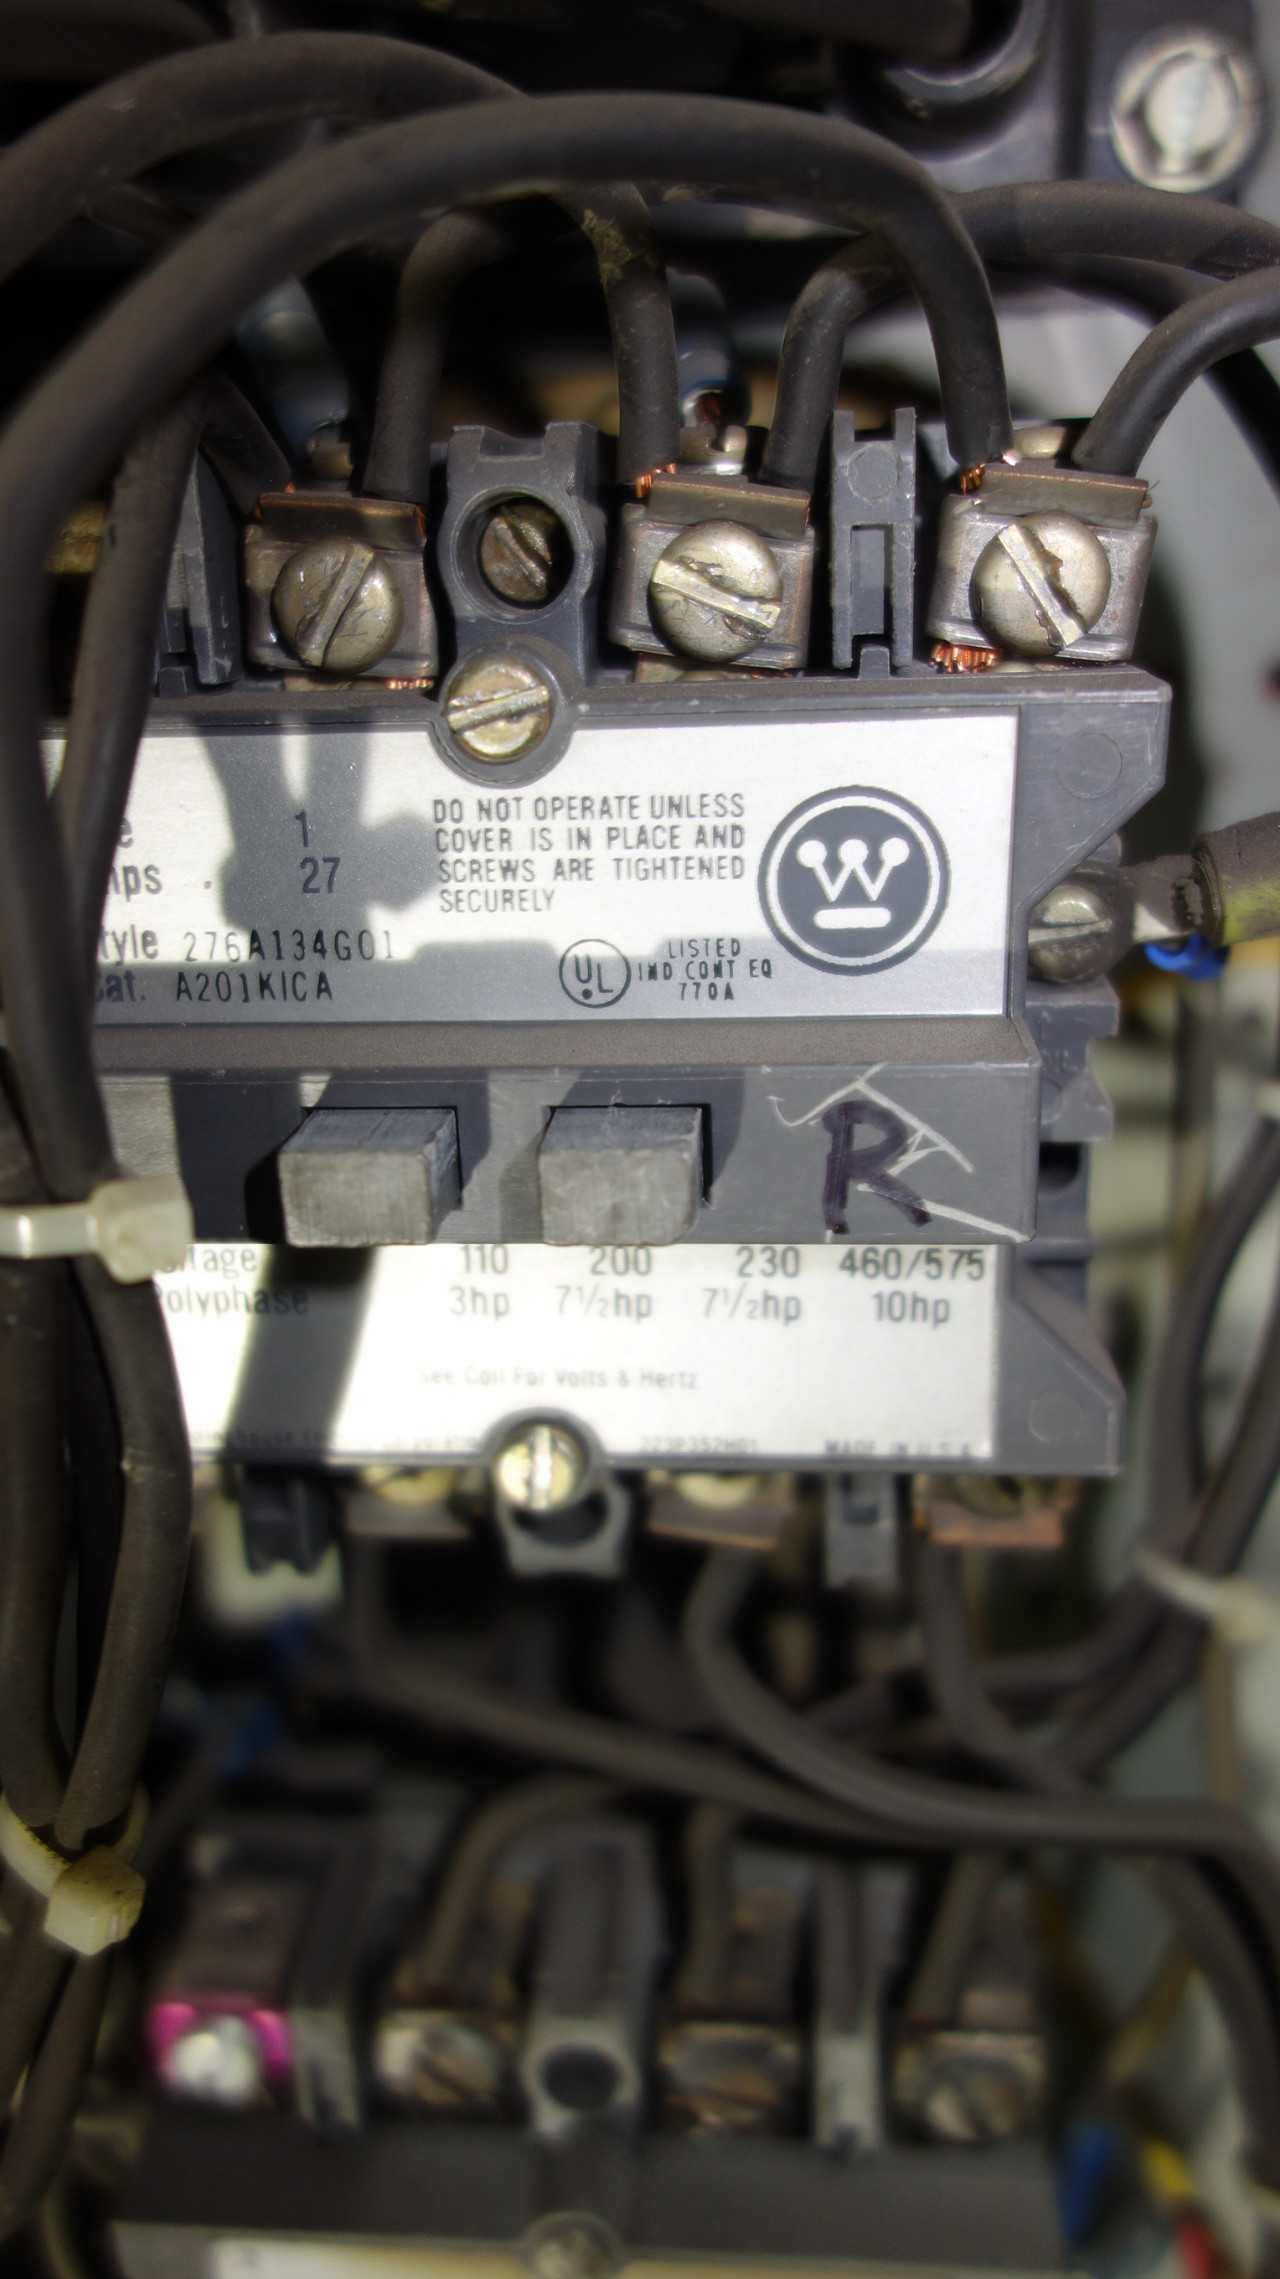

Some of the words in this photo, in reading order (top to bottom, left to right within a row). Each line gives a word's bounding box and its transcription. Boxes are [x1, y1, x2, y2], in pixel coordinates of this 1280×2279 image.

[433, 798, 463, 823] DO
[477, 797, 523, 822] NOT
[534, 795, 640, 820] OPERATE
[650, 793, 744, 819] UNLESS
[295, 809, 309, 848] 1
[435, 828, 512, 852] COVER
[531, 827, 553, 851] IS
[569, 827, 591, 850] IN
[606, 825, 681, 850] PLACE
[695, 824, 745, 849] AND
[301, 857, 340, 894] 27
[439, 858, 535, 883] SCREWS
[553, 857, 594, 881] ARE
[613, 855, 745, 881] TIGHTENED
[440, 888, 555, 913] SECURELY
[668, 937, 741, 959] LISTED
[638, 961, 673, 981] IND
[686, 959, 735, 980] CONT
[750, 959, 772, 979] EQ
[679, 982, 734, 1001] 770A
[821, 1100, 932, 1235] R
[460, 1244, 509, 1275] 110
[590, 1246, 653, 1277] 200
[737, 1246, 801, 1279] 230
[839, 1248, 985, 1281] 460/575
[158, 1286, 310, 1317] olyphase
[450, 1286, 510, 1319] 3hp
[872, 1292, 951, 1328] 10hp
